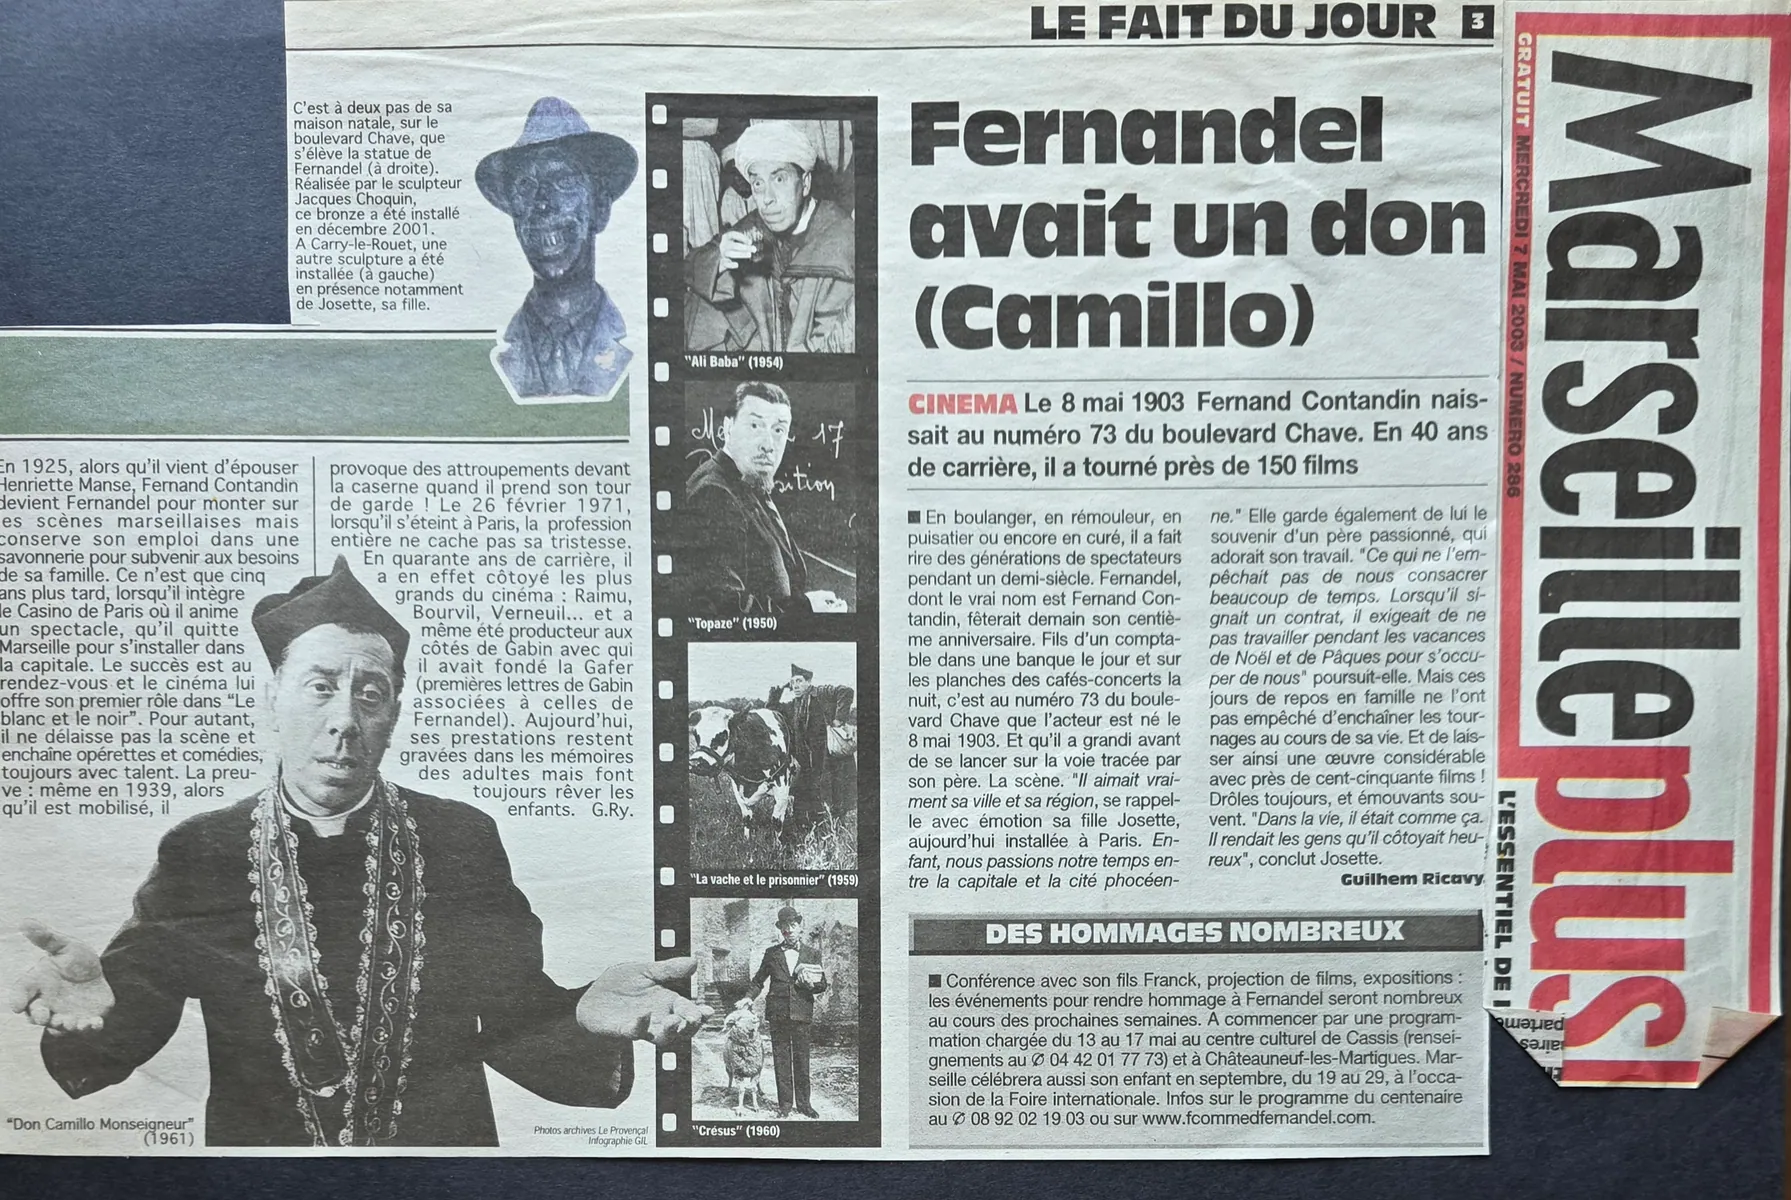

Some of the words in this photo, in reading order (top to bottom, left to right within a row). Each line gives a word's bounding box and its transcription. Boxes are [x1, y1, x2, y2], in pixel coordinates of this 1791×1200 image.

[1031, 5, 1085, 39] LE
[1095, 3, 1212, 39] FAIT
[1224, 3, 1292, 38] DU
[1304, 2, 1436, 38] JOUR
[1471, 12, 1485, 30] 3
[1515, 31, 1533, 128] GRATUIT
[293, 100, 329, 114] C'est
[334, 100, 342, 114] à
[347, 100, 380, 114] deux
[386, 103, 409, 116] pas
[415, 100, 431, 113] de
[437, 103, 451, 113] sa
[294, 116, 342, 129] maison
[348, 115, 394, 130] natale,
[400, 119, 422, 128] sur
[426, 115, 438, 128] le
[911, 95, 1383, 166] Fernandel
[294, 131, 362, 144] boulevard
[368, 131, 414, 145] Chave,
[420, 134, 444, 146] que
[294, 146, 342, 159] s'élève
[348, 146, 358, 159] la
[364, 148, 409, 159] statue
[414, 145, 431, 159] de
[294, 161, 361, 175] Fernandel
[366, 161, 381, 176] (à
[386, 161, 438, 176] droite).
[295, 176, 350, 190] Réalisée
[355, 180, 377, 192] par
[382, 176, 392, 189] le
[398, 176, 462, 192] sculpteur
[1514, 135, 1530, 238] MERCREDI
[294, 192, 351, 208] Jacques
[356, 191, 416, 208] Choquin,
[909, 188, 1151, 259] avait
[1174, 200, 1288, 258] un
[1310, 188, 1485, 256] don
[1514, 244, 1528, 255] 7
[1511, 261, 1528, 298] MAI
[915, 280, 1313, 350] (Camillo)
[1509, 304, 1525, 353] 2003
[748, 355, 783, 370] (1954)
[908, 393, 1017, 414] CINEMA
[1025, 392, 1051, 412] Le
[1061, 392, 1075, 412] 8
[1083, 391, 1123, 412] mai
[1132, 391, 1184, 411] 1903
[1198, 390, 1290, 411] Fernand
[1302, 389, 1419, 410] Contandin
[1431, 388, 1487, 408] nais-
[1507, 372, 1524, 457] NUMERO
[812, 420, 844, 459] 17
[908, 424, 948, 444] sait
[957, 429, 984, 445] au
[994, 424, 1080, 446] numéro
[1090, 423, 1116, 444] 73
[1125, 423, 1153, 443] du
[1163, 422, 1275, 443] boulevard
[1285, 422, 1363, 443] Chave.
[1374, 421, 1401, 441] En
[1411, 420, 1438, 441] 40
[1447, 425, 1487, 441] ans
[330, 464, 407, 480] provoque
[413, 461, 441, 475] des
[447, 463, 569, 480] attroupements
[574, 461, 630, 476] devant
[908, 456, 935, 476] de
[943, 456, 1036, 481] carrière,
[1045, 456, 1055, 476] il
[1063, 461, 1075, 476] a
[1083, 455, 1157, 476] tourné
[1165, 455, 1214, 480] près
[1222, 454, 1249, 475] de
[1258, 454, 1296, 475] 150
[1303, 454, 1358, 474] films
[1506, 462, 1521, 499] 286
[1211, 528, 1277, 543] souvenir
[1284, 528, 1318, 543] d'un
[1327, 528, 1361, 546] père
[1370, 526, 1454, 545] passionné,
[1462, 525, 1486, 544] qui
[908, 570, 971, 589] pendant
[977, 574, 995, 585] un
[1001, 570, 1093, 585] demi-siècle.
[1100, 569, 1180, 586] Fernandel,
[413, 604, 479, 621] Bourvil,
[491, 605, 582, 620] Verneuil...
[594, 607, 612, 620] et
[623, 609, 632, 621] a
[742, 616, 776, 630] (1950)
[0, 692, 40, 707] offre
[45, 697, 73, 707] son
[79, 696, 142, 711] premier
[147, 692, 177, 707] rôle
[183, 692, 221, 708] dans
[508, 801, 574, 816] enfants.
[592, 801, 633, 820] G.Ry.
[1341, 872, 1417, 885] Guilhem
[1494, 790, 1516, 949] L'ESSENTIEL
[710, 873, 740, 884] vache
[743, 875, 753, 884] et
[756, 874, 766, 884] le
[828, 874, 858, 887] (1959)
[986, 923, 1042, 944] DES
[1050, 921, 1222, 943] HOMMAGES
[1230, 920, 1404, 942] NOMBREUX
[1493, 957, 1512, 991] DE
[929, 993, 950, 1007] les
[955, 992, 1047, 1007] événements
[1053, 996, 1088, 1010] pour
[1093, 992, 1143, 1007] rendre
[1148, 992, 1226, 1009] hommage
[1231, 991, 1241, 1006] à
[1246, 990, 1323, 1005] Fernandel
[1328, 991, 1377, 1005] seront
[1383, 990, 1462, 1004] nombreux
[45, 1117, 94, 1130] Camillo
[928, 1115, 947, 1125] au
[971, 1111, 989, 1125] 08
[994, 1111, 1013, 1125] 92
[1018, 1111, 1037, 1125] 02
[1043, 1111, 1060, 1125] 19
[1066, 1111, 1084, 1125] 03
[1089, 1114, 1108, 1125] ou
[1113, 1114, 1137, 1125] sur
[1142, 1109, 1375, 1125] www.fcommedfernandel.com.
[144, 1131, 193, 1146] (1961)
[746, 1125, 780, 1137] (1960)
